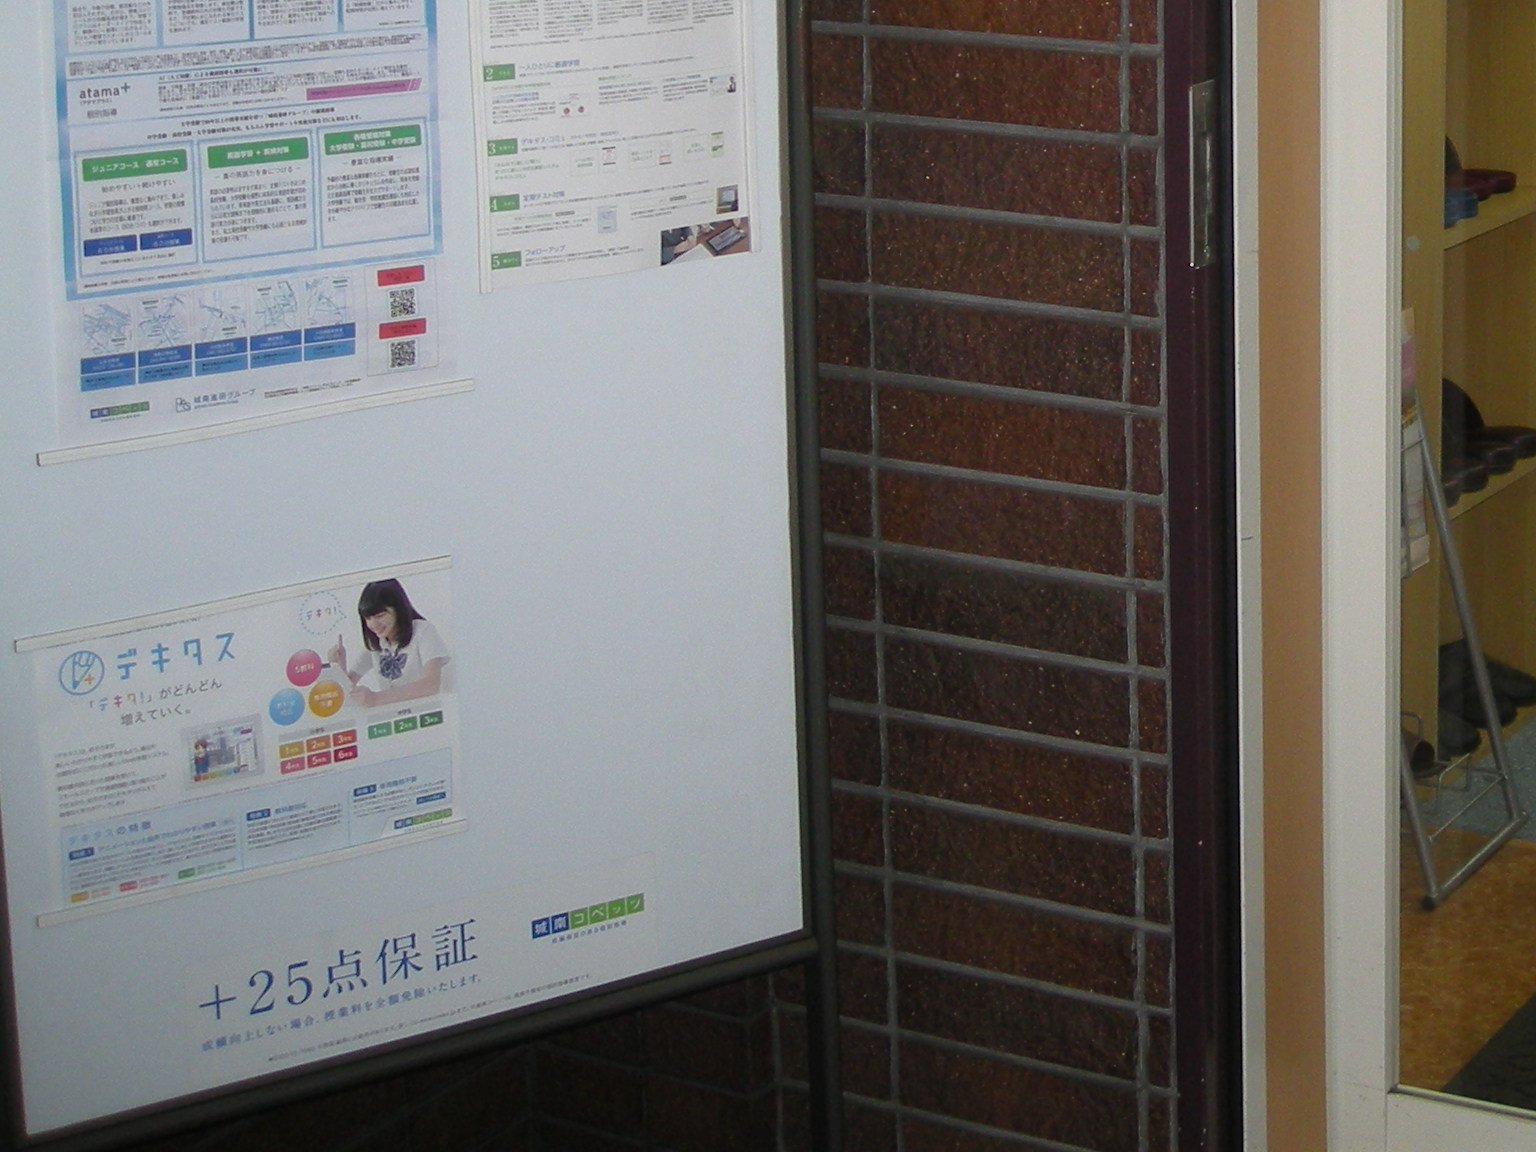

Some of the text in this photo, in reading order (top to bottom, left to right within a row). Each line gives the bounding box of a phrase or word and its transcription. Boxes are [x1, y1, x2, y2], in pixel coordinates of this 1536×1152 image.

[79, 82, 132, 100] atama+
[117, 632, 236, 680] デキタス
[120, 703, 191, 726] 増えていく。
